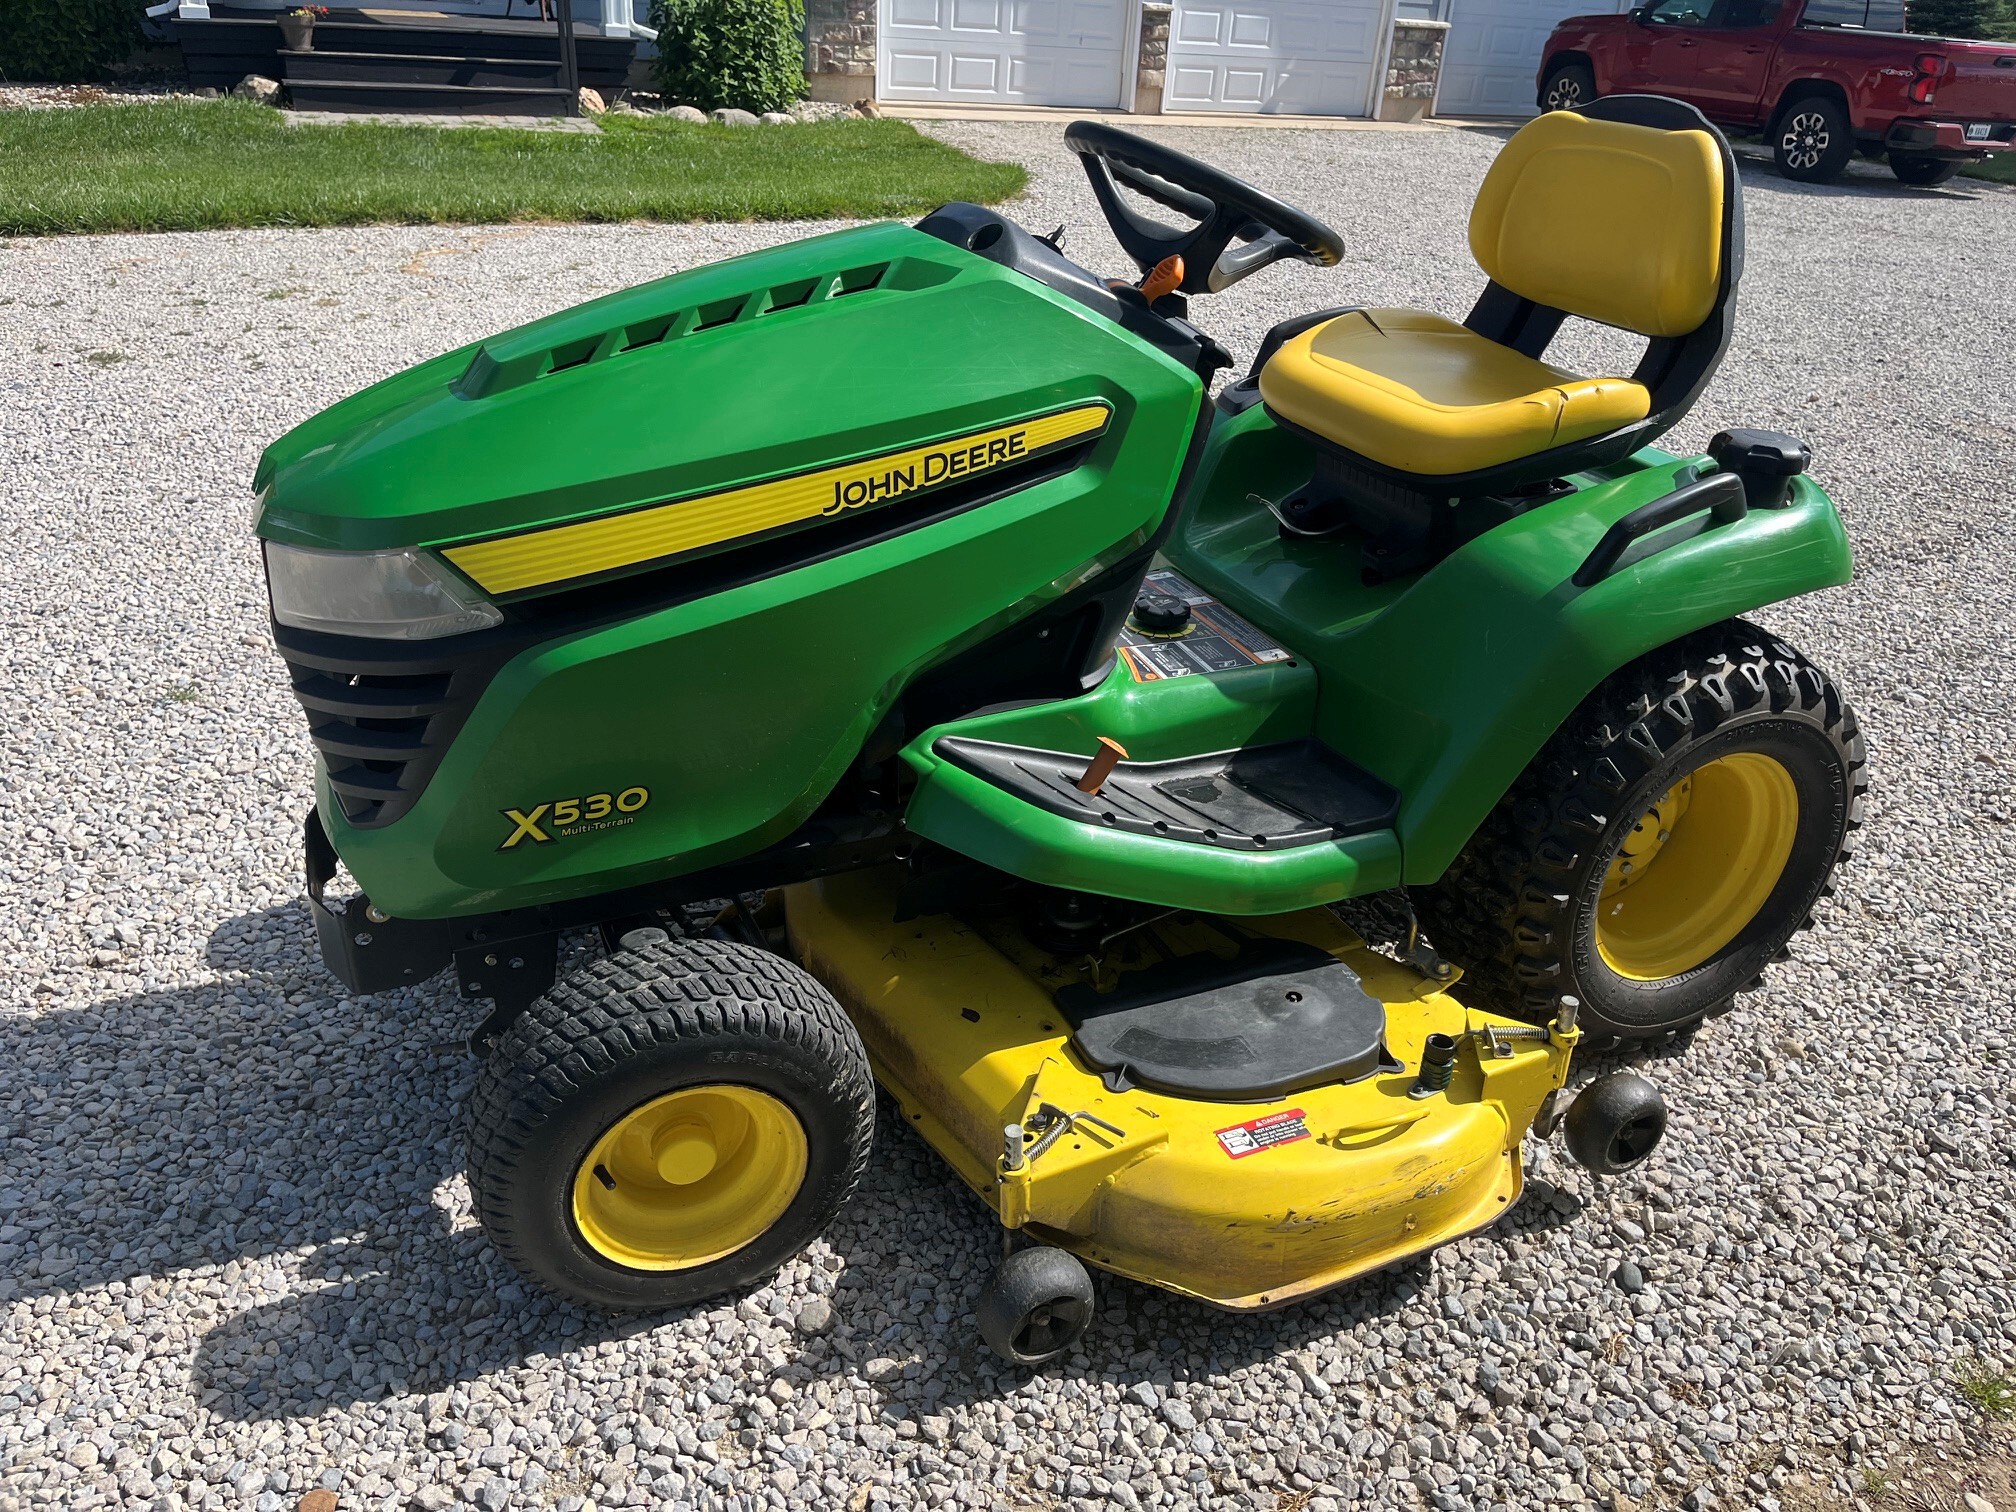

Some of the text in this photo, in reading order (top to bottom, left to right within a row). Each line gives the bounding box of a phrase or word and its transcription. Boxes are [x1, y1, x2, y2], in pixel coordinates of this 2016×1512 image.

[822, 430, 1028, 516] JOHN DEERE
[499, 786, 650, 850] X530
[562, 816, 634, 837] Multi-Terrain
[1254, 1124, 1281, 1134] ROTATING
[1261, 1113, 1289, 1125] DANGER
